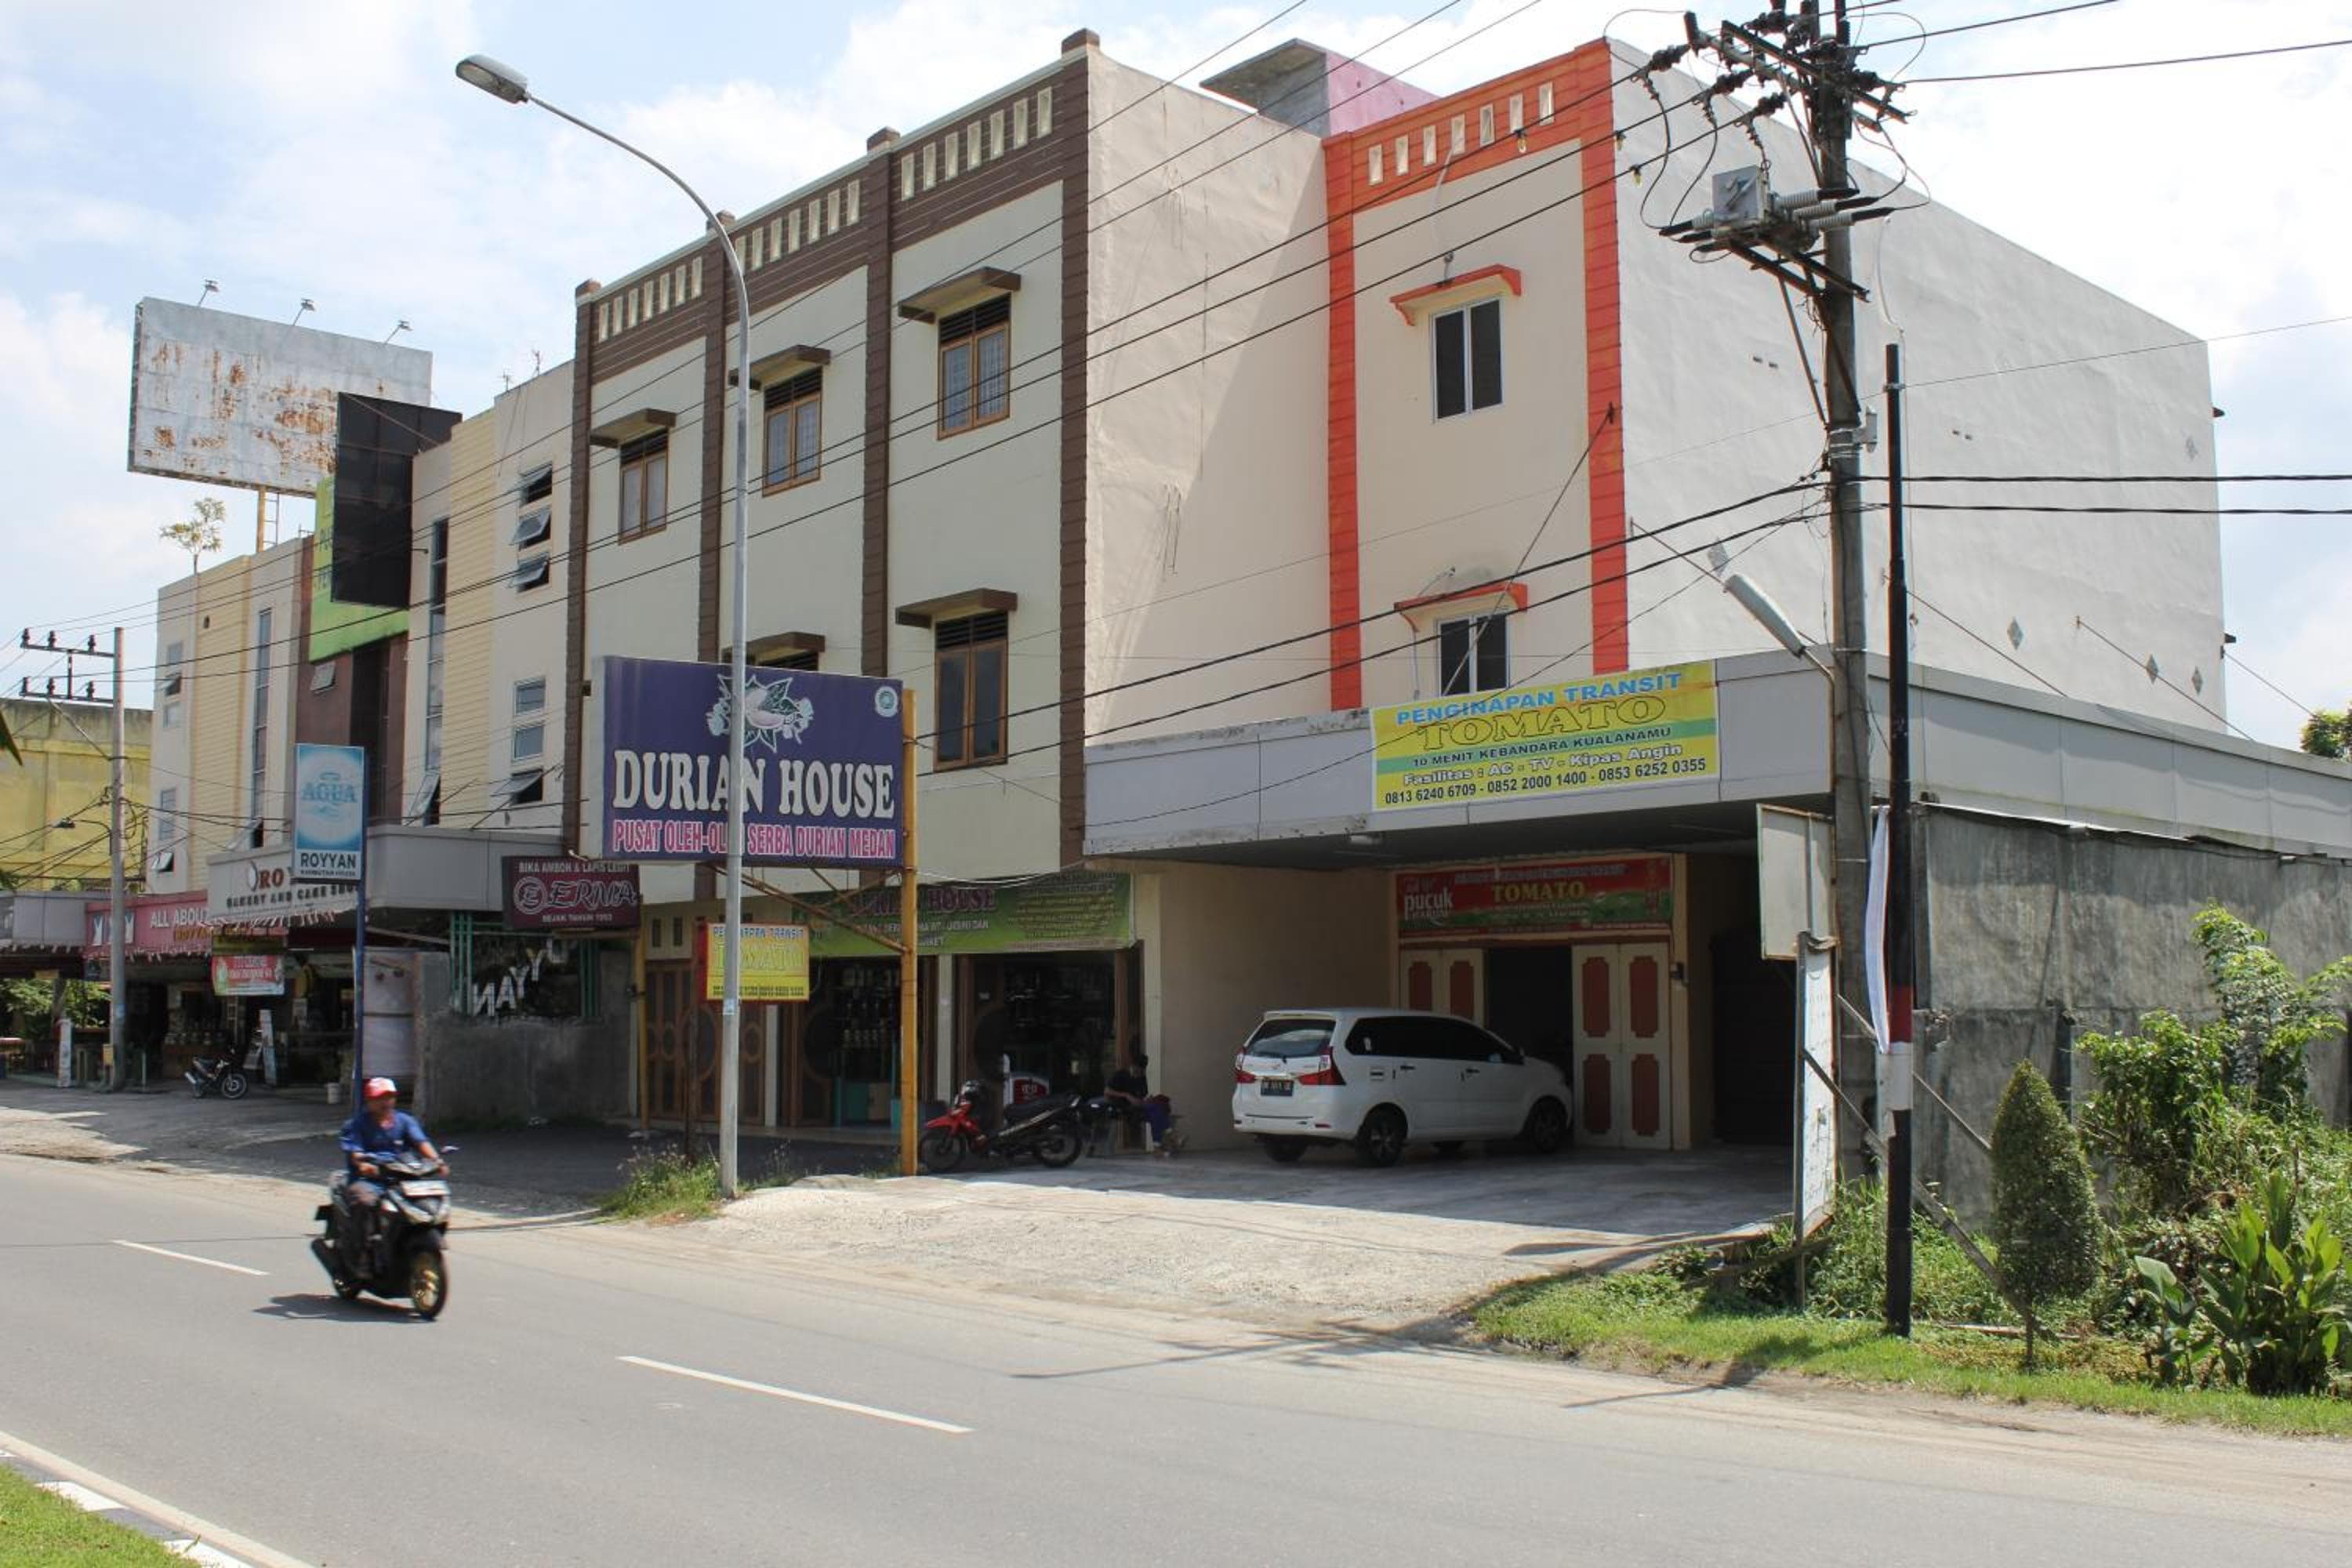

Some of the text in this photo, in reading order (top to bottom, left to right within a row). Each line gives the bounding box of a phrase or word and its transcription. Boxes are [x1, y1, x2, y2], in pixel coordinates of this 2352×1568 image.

[1396, 673, 1681, 726] PENGINAPAN TRANSIT
[1417, 695, 1666, 750] TOMATO
[1404, 768, 1474, 786] Fasilitas
[1489, 762, 1515, 776] AC
[1530, 757, 1554, 771] TV
[1569, 751, 1623, 768] Kipas
[1627, 743, 1683, 760] Angin
[1432, 753, 1474, 765] MENIT
[1479, 739, 1568, 759] KEBANDARA
[1573, 727, 1671, 747] KUALANAMU
[300, 782, 358, 804] AQUA
[613, 750, 895, 818] DURIAN HOUSE
[1385, 790, 1413, 804] 0813
[1416, 788, 1444, 801] 6240
[1448, 784, 1476, 797] 6709
[1487, 779, 1518, 793] 0852
[1522, 775, 1552, 789] 2000
[1555, 771, 1586, 786] 1400
[1599, 766, 1631, 781] 0853
[1635, 762, 1668, 777] 6252
[1671, 757, 1707, 773] 0355
[613, 819, 895, 859] PUSAT OLEH-OL SERBA DURIAN MEDAN
[301, 853, 357, 869] ROYYAN
[518, 862, 540, 873] BIKA
[1405, 887, 1453, 920] pucuk
[1492, 880, 1584, 902] TOMATO
[151, 908, 169, 928] ALL
